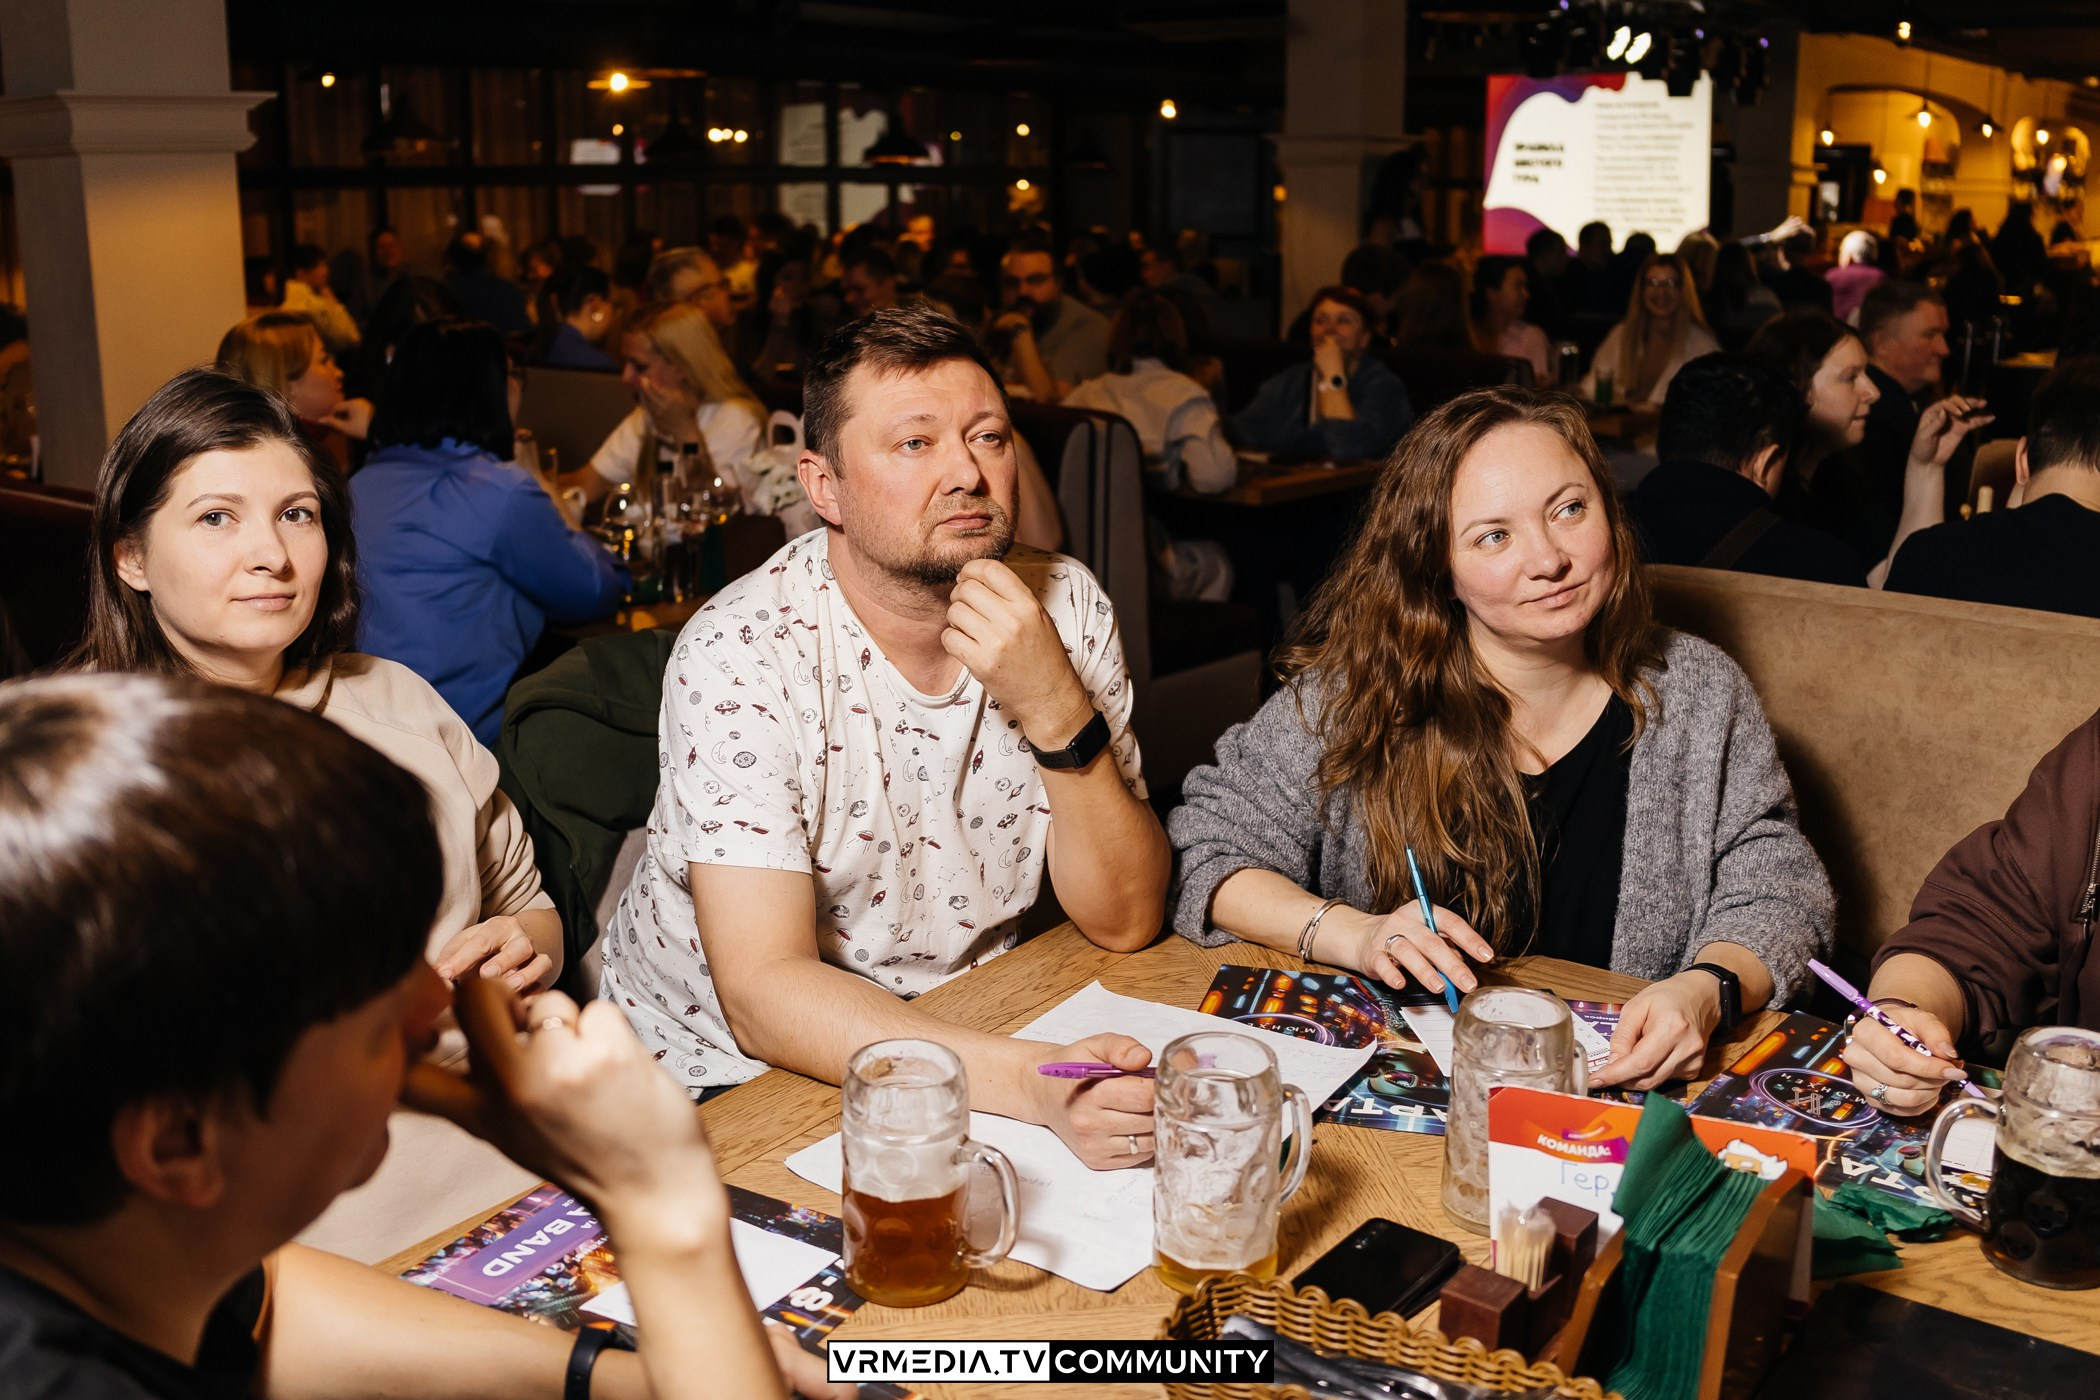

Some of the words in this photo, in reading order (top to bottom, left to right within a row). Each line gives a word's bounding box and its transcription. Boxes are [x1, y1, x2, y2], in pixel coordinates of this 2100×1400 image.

[1780, 1072, 1868, 1105] МЮНХЕН
[1537, 1134, 1612, 1158] КОМАНДА:
[1561, 1161, 1615, 1197] Гер
[482, 1218, 576, 1277] BAND
